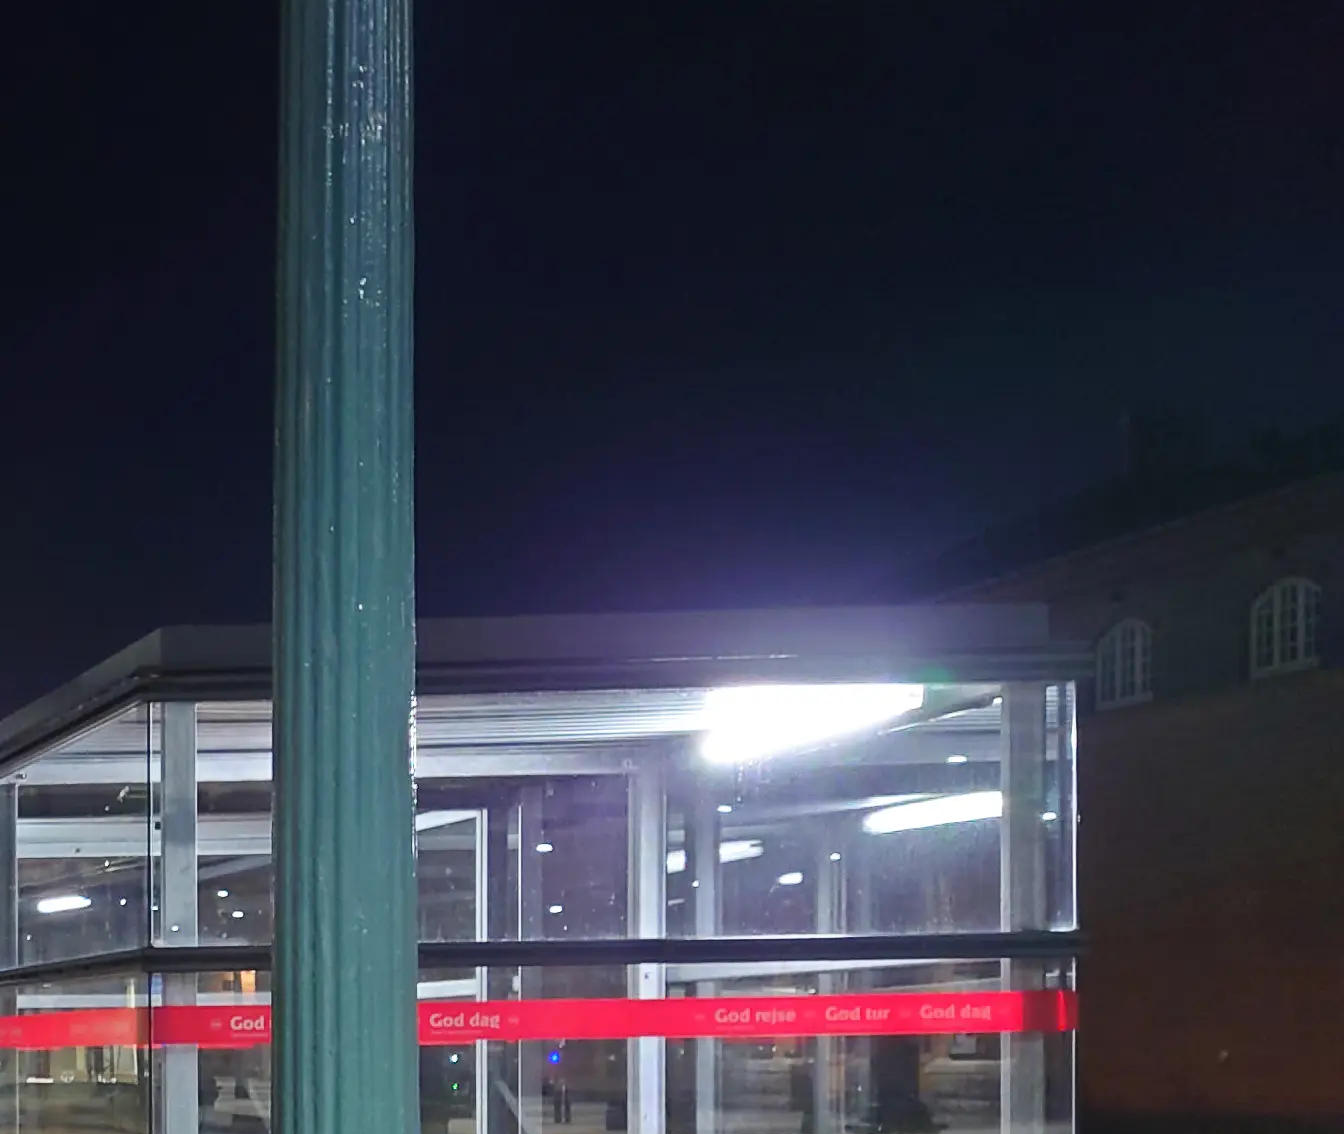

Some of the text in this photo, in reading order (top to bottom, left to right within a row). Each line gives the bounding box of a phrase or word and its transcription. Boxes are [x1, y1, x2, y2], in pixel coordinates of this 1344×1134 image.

[230, 1015, 265, 1031] God
[429, 1011, 500, 1029] God dag
[715, 1003, 992, 1025] God rejse God tur God dag
